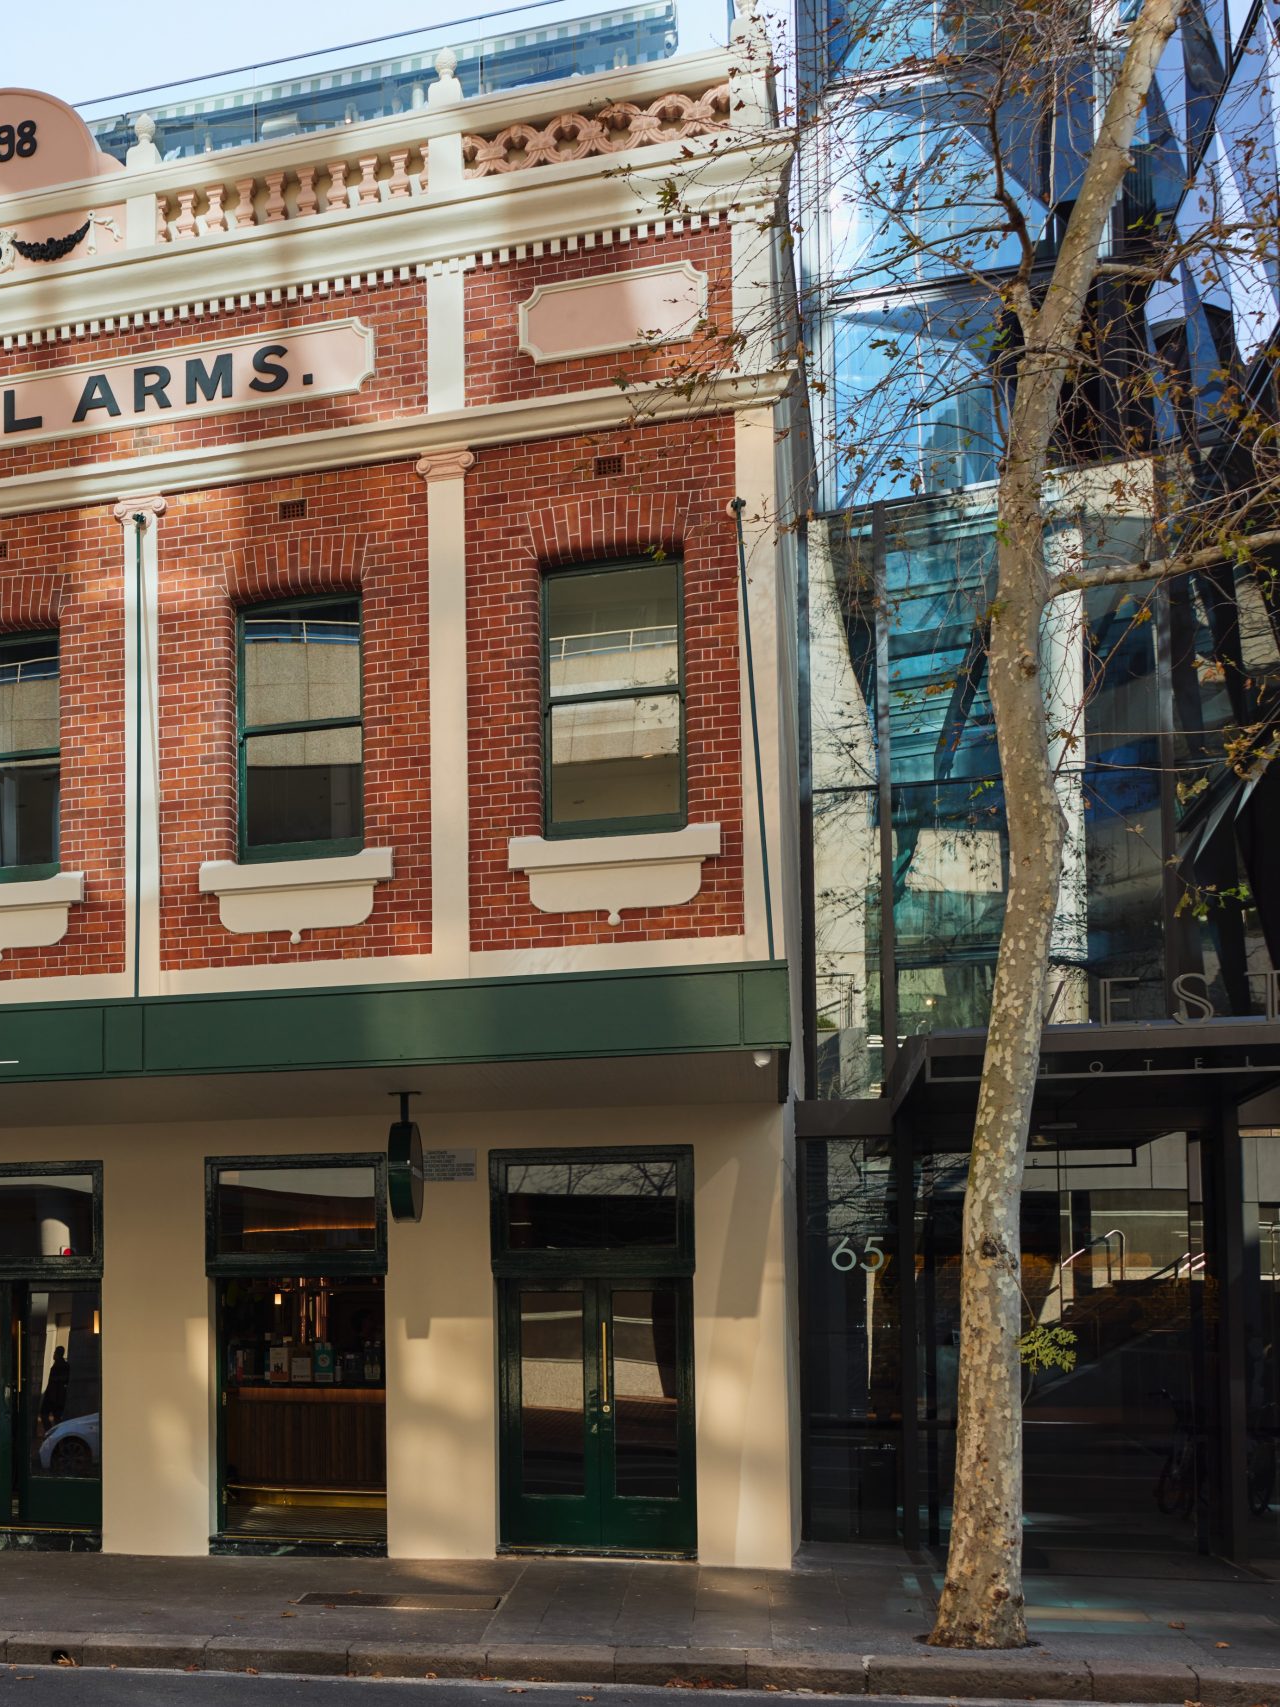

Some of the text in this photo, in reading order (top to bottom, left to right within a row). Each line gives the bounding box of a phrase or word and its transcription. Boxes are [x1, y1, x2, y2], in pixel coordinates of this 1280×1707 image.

[72, 344, 314, 424] ARMS.
[1043, 969, 1280, 1029] EST
[831, 1236, 885, 1272] 65
